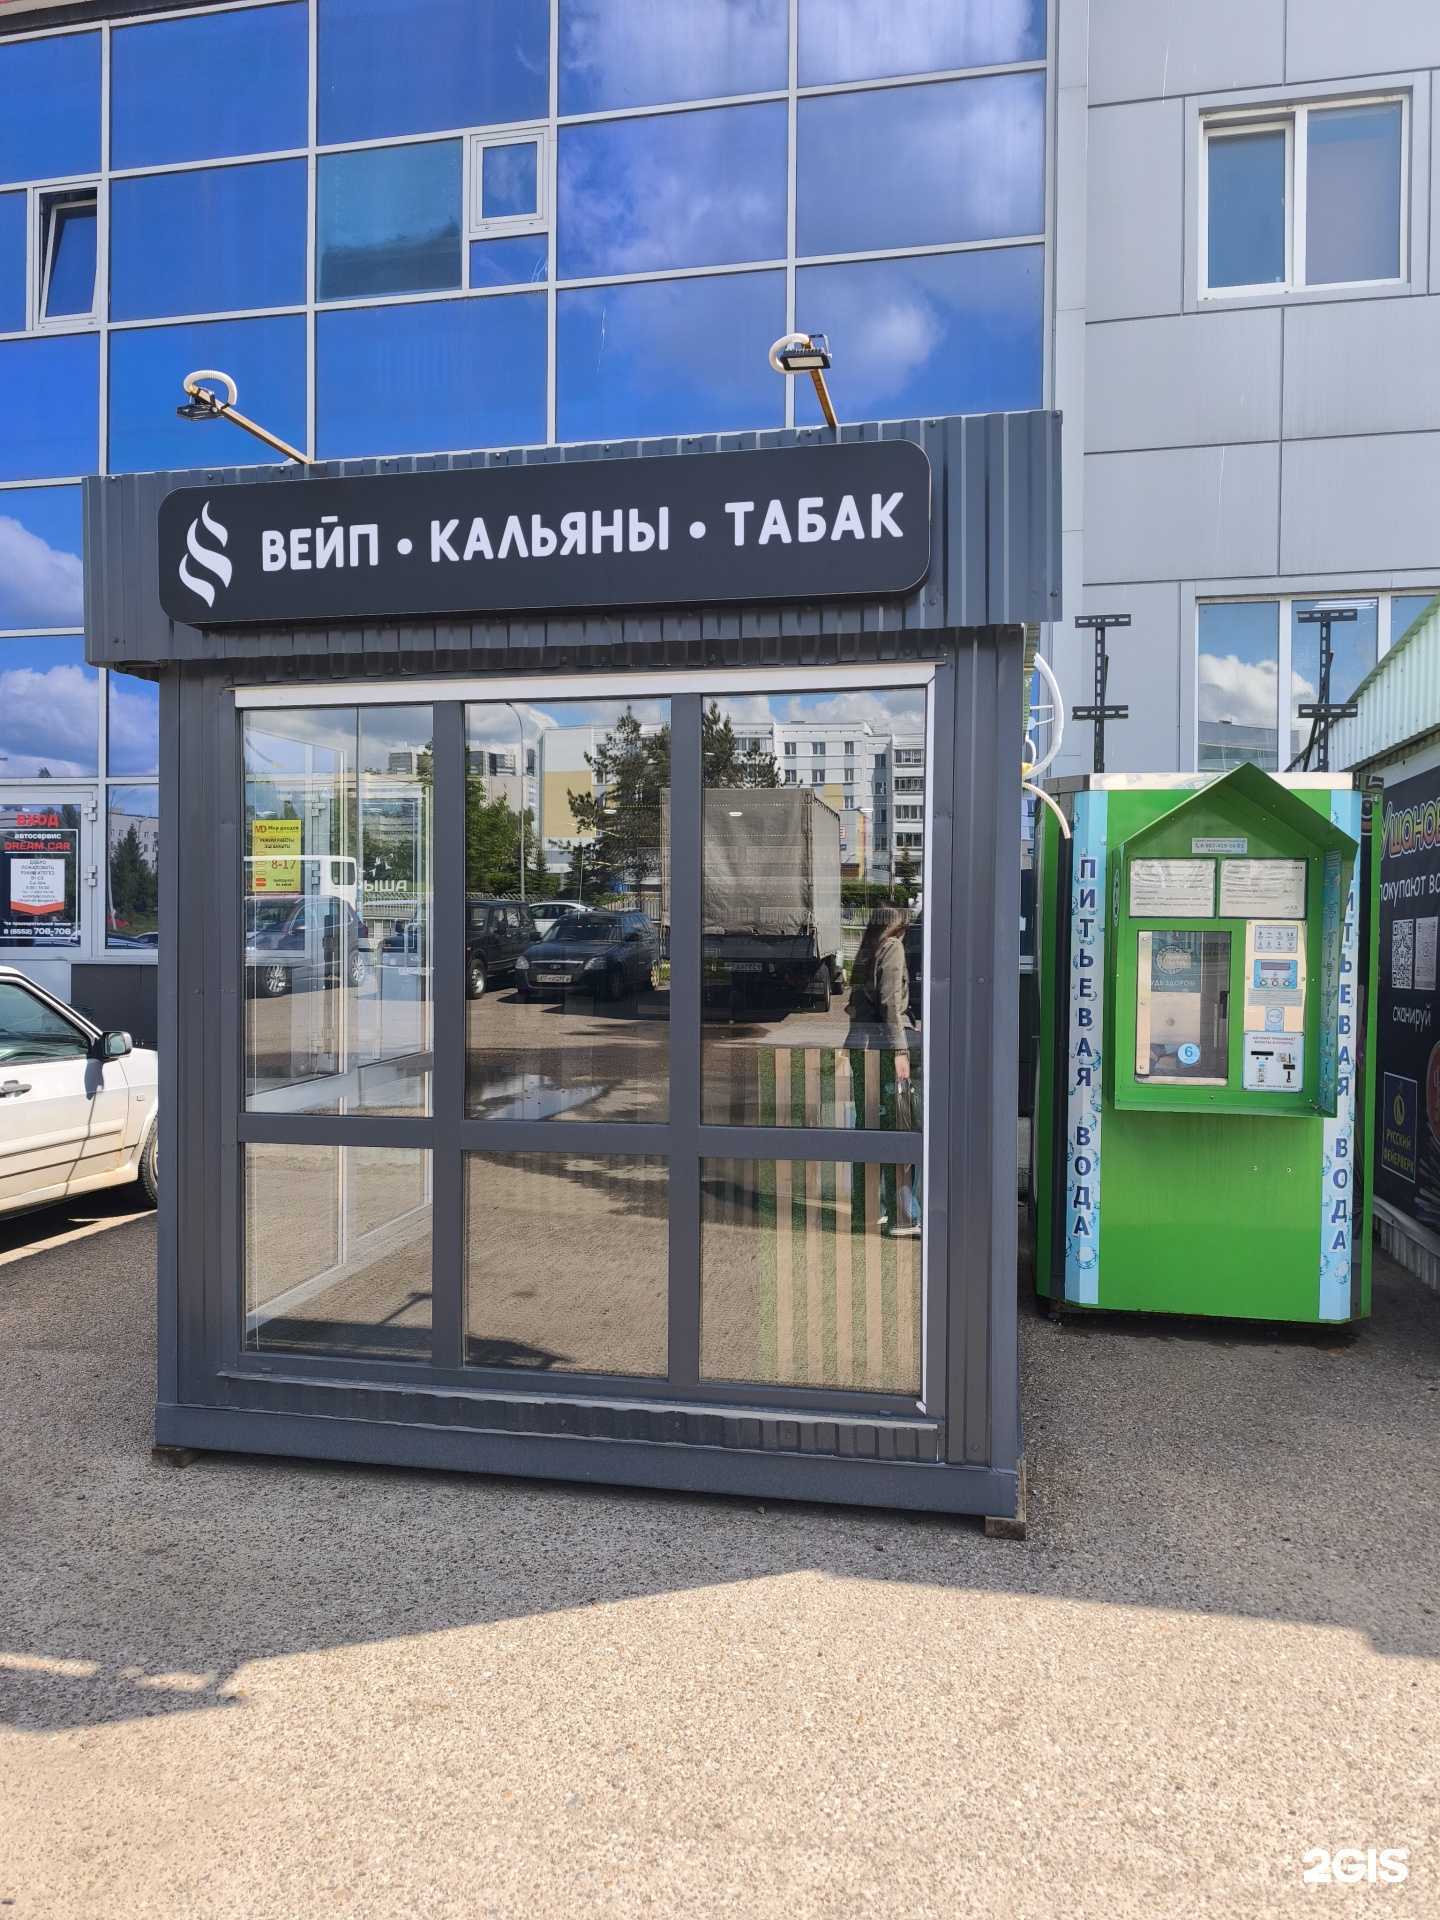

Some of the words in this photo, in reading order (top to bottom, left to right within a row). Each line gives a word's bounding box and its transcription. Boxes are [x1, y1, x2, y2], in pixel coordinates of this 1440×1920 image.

[261, 515, 379, 573] ВЕЙП
[430, 505, 671, 564] КАЛЬЯНЫ
[724, 490, 905, 547] ТАБАК
[1074, 857, 1097, 1088] ПИТЬЕВАЯ
[1392, 1003, 1431, 1032] сканируй
[1185, 1046, 1193, 1057] 6
[1072, 1126, 1095, 1238] ВОДА
[1330, 1137, 1349, 1252] ВОДА
